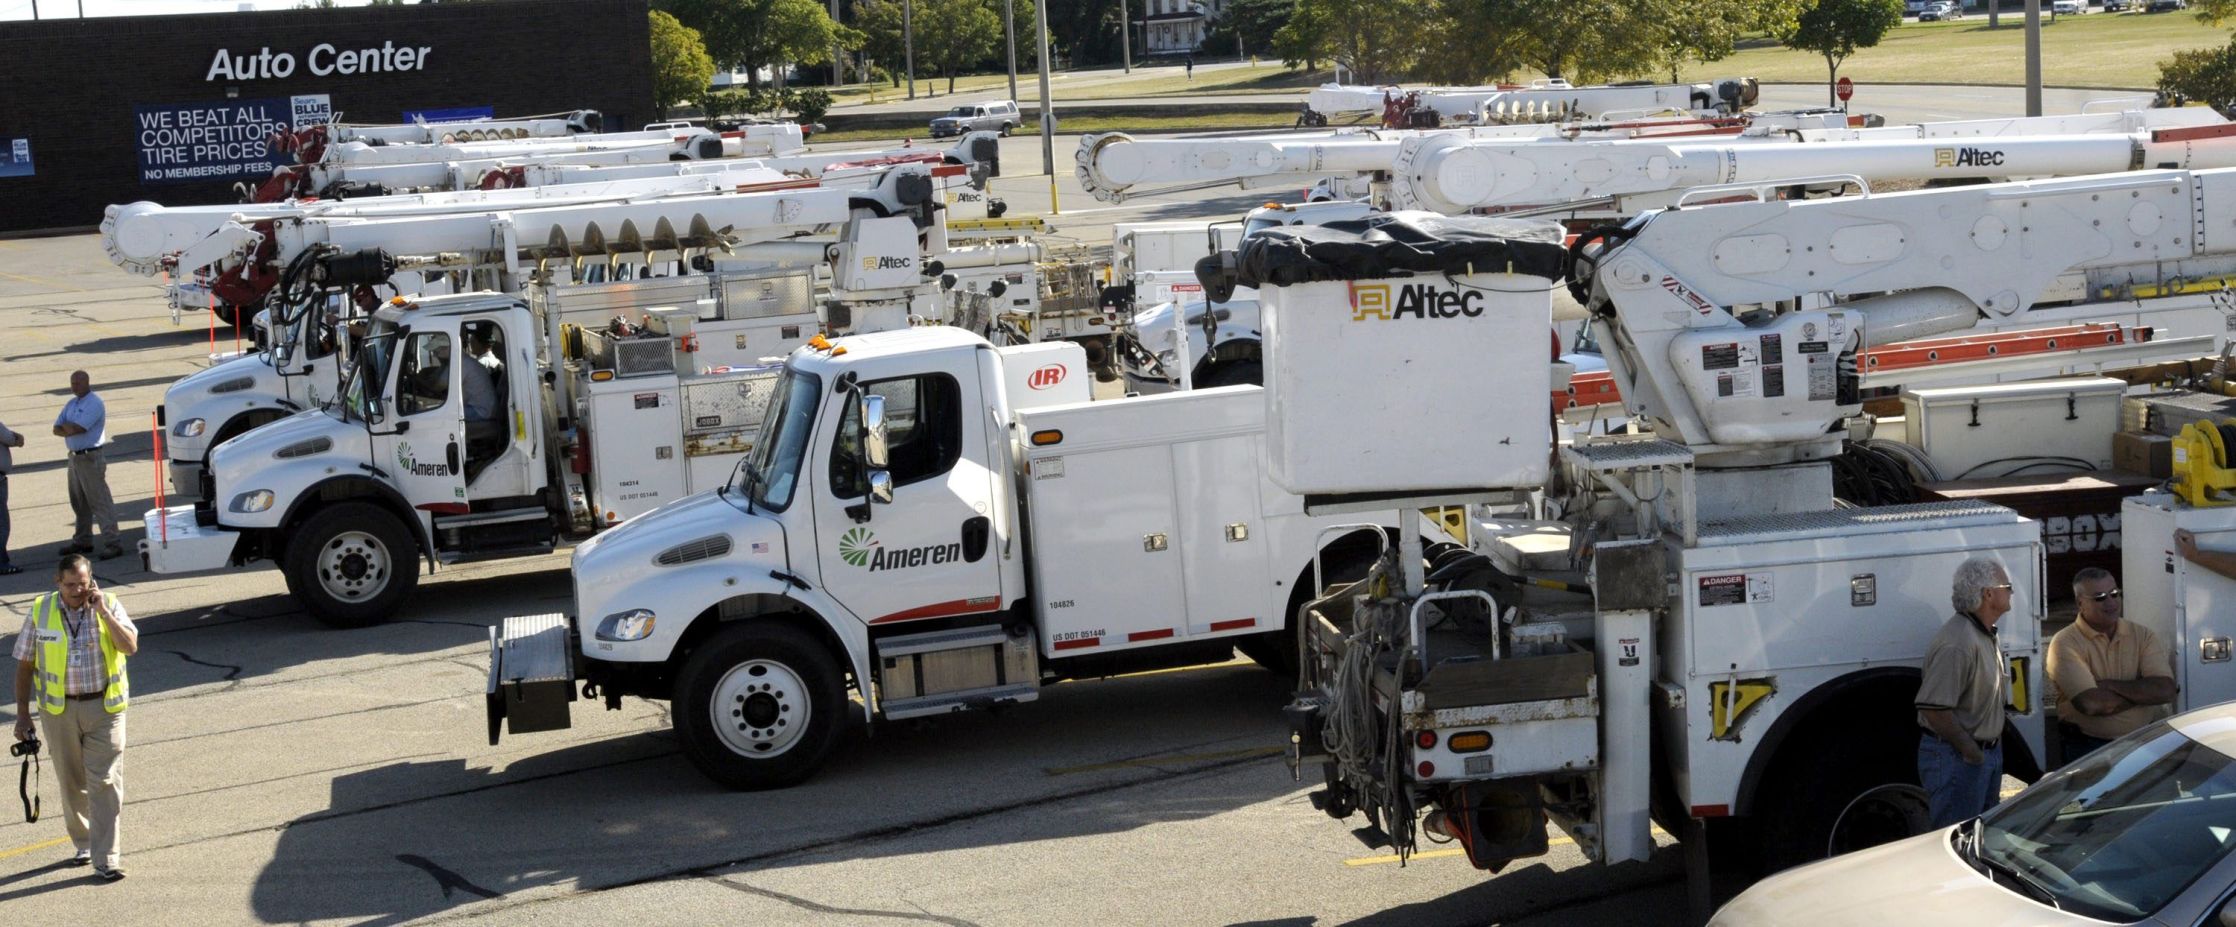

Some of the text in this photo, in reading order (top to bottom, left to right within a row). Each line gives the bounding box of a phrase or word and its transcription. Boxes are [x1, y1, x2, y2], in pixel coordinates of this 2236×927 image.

[206, 40, 431, 81] Auto Center
[1837, 84, 1853, 94] STOP
[139, 106, 272, 129] WE BEAT ALL
[295, 103, 329, 114] BLUE
[296, 117, 330, 127] CREW
[141, 121, 288, 147] COMPETITORS
[142, 141, 267, 165] TIRE PRICES
[1956, 147, 2005, 167] Altec
[145, 161, 273, 180] NO MEMBERSHIP FEES
[957, 192, 982, 202] Altec
[878, 256, 911, 270] Altec
[1393, 283, 1484, 319] Altec
[1034, 368, 1060, 386] IR
[410, 457, 448, 477] Ameren
[869, 542, 960, 572] Ameren
[1710, 576, 1742, 585] DANGER
[1052, 633, 1063, 642] US
[1064, 631, 1079, 640] DOT
